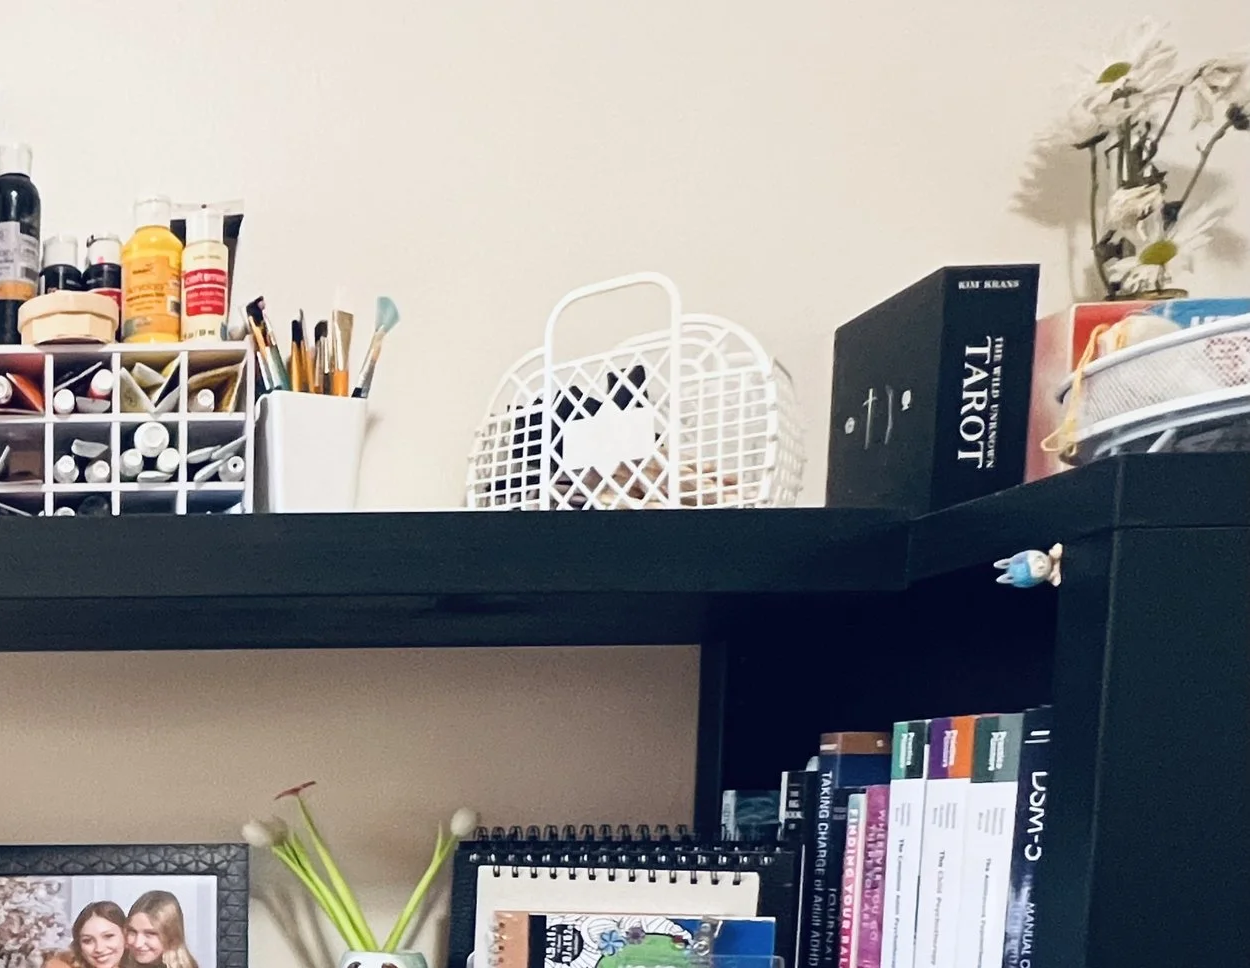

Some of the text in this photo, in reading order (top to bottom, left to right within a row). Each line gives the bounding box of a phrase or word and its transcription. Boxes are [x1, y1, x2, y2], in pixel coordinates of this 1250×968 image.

[958, 279, 1020, 289] KIM KRANS
[957, 335, 992, 470] TAROT
[986, 337, 1004, 469] THE WILD UNKNOWN
[808, 770, 832, 966] TAKING CHARGE of Adult ADHD
[844, 807, 858, 877] FINDING
[841, 883, 852, 929] YOUR
[871, 888, 880, 913] YOU
[1021, 902, 1035, 954] MANUAL
